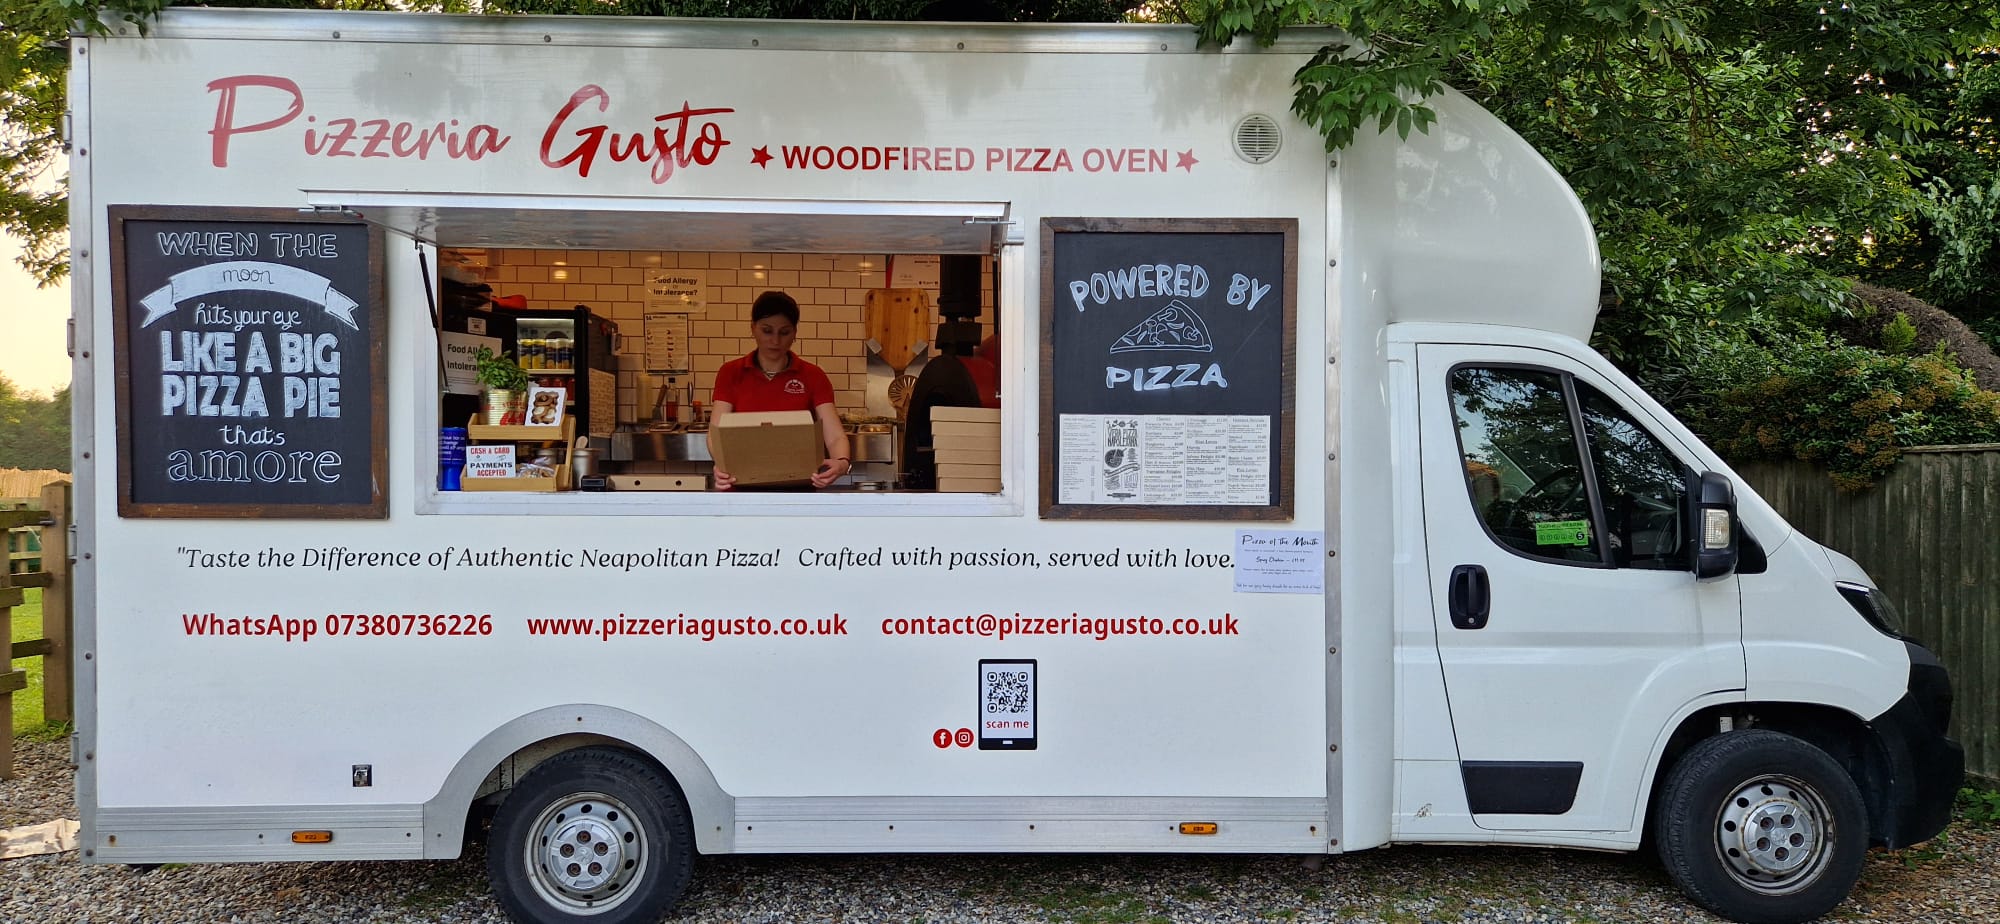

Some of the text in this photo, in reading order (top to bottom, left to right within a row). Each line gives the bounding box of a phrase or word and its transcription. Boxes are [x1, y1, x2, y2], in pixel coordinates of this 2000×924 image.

[206, 74, 735, 184] Pizzeria Gusto
[782, 145, 1168, 173] WOODFIRED PIZZA OVEN
[158, 232, 338, 258] WHEN THE
[222, 267, 274, 285] moon
[1069, 263, 1272, 312] POWERED BY
[196, 303, 302, 331] hits your eye
[161, 331, 341, 375] LIKE A BIG
[447, 343, 466, 353] Food
[447, 361, 480, 371] Intolera
[1106, 363, 1228, 392] PIZZA
[161, 374, 341, 419] PIZZA PIE
[168, 449, 342, 483] amore
[1269, 537, 1276, 546] of
[1278, 537, 1288, 545] the
[1293, 536, 1319, 547] Month
[177, 547, 1236, 572] "Taste the Difference of Authentic Neapolitan Pizza! Crafted with passion, served with love.
[182, 613, 493, 642] WhatsApp 07380736226
[527, 613, 848, 642] www.pizzeriagusto.co.uk
[881, 613, 1239, 641] contact@pizzeriagusto.co.uk
[986, 720, 1030, 729] scan me
